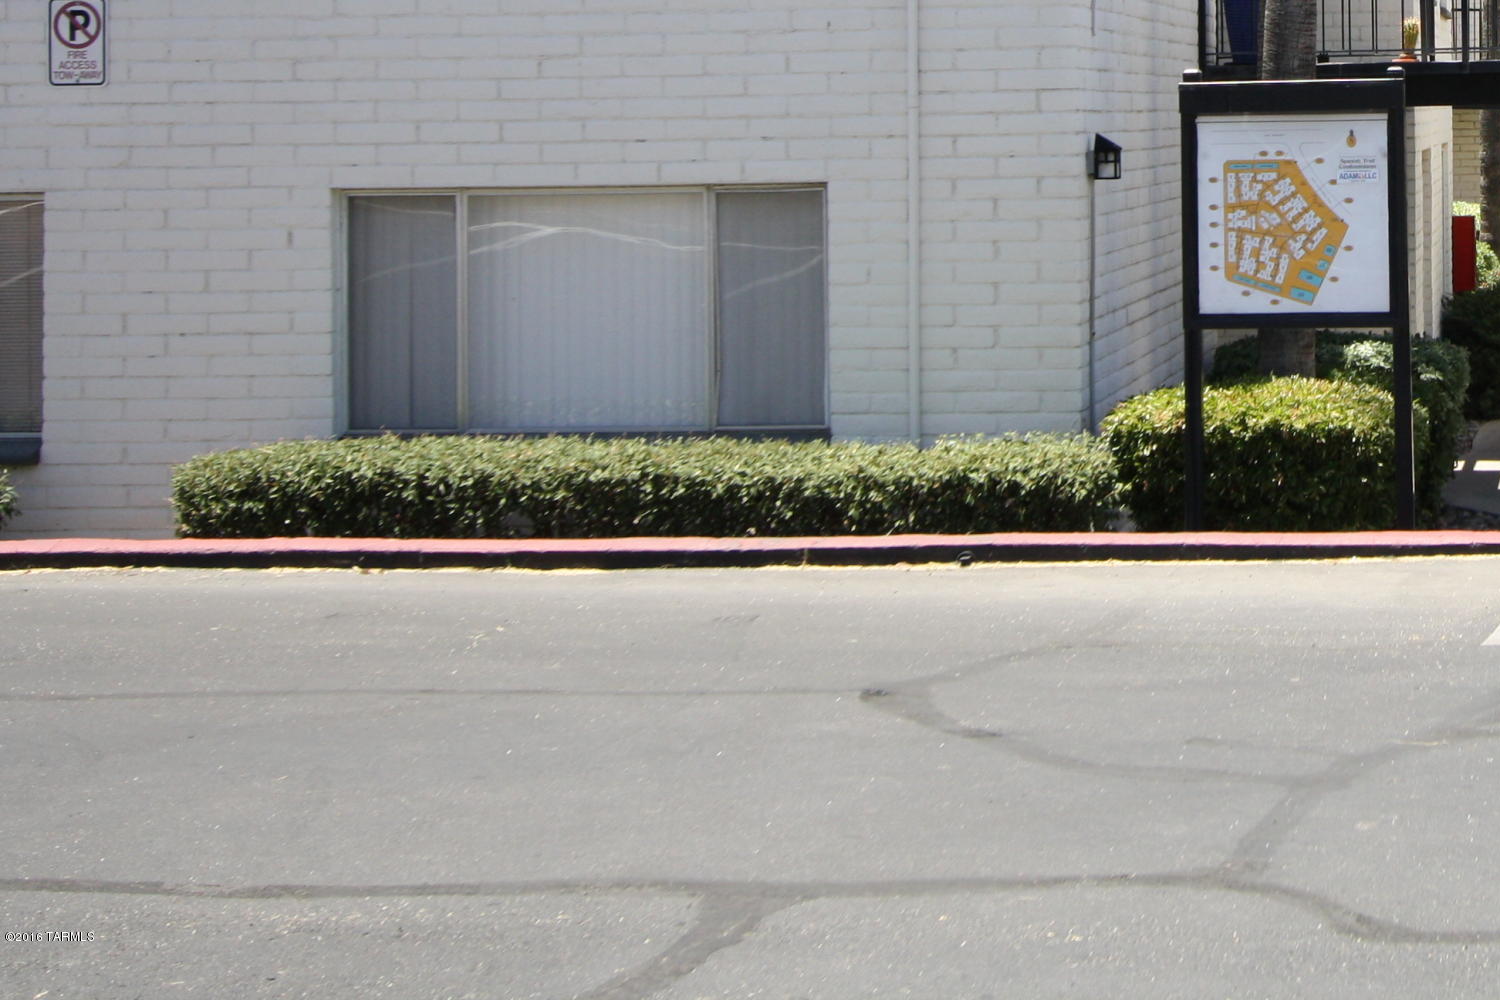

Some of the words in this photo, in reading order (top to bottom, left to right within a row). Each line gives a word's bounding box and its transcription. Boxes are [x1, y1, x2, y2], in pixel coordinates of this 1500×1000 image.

[67, 50, 87, 59] FIRE
[59, 60, 97, 70] ACCESS
[53, 71, 102, 79] TOW-AWAY
